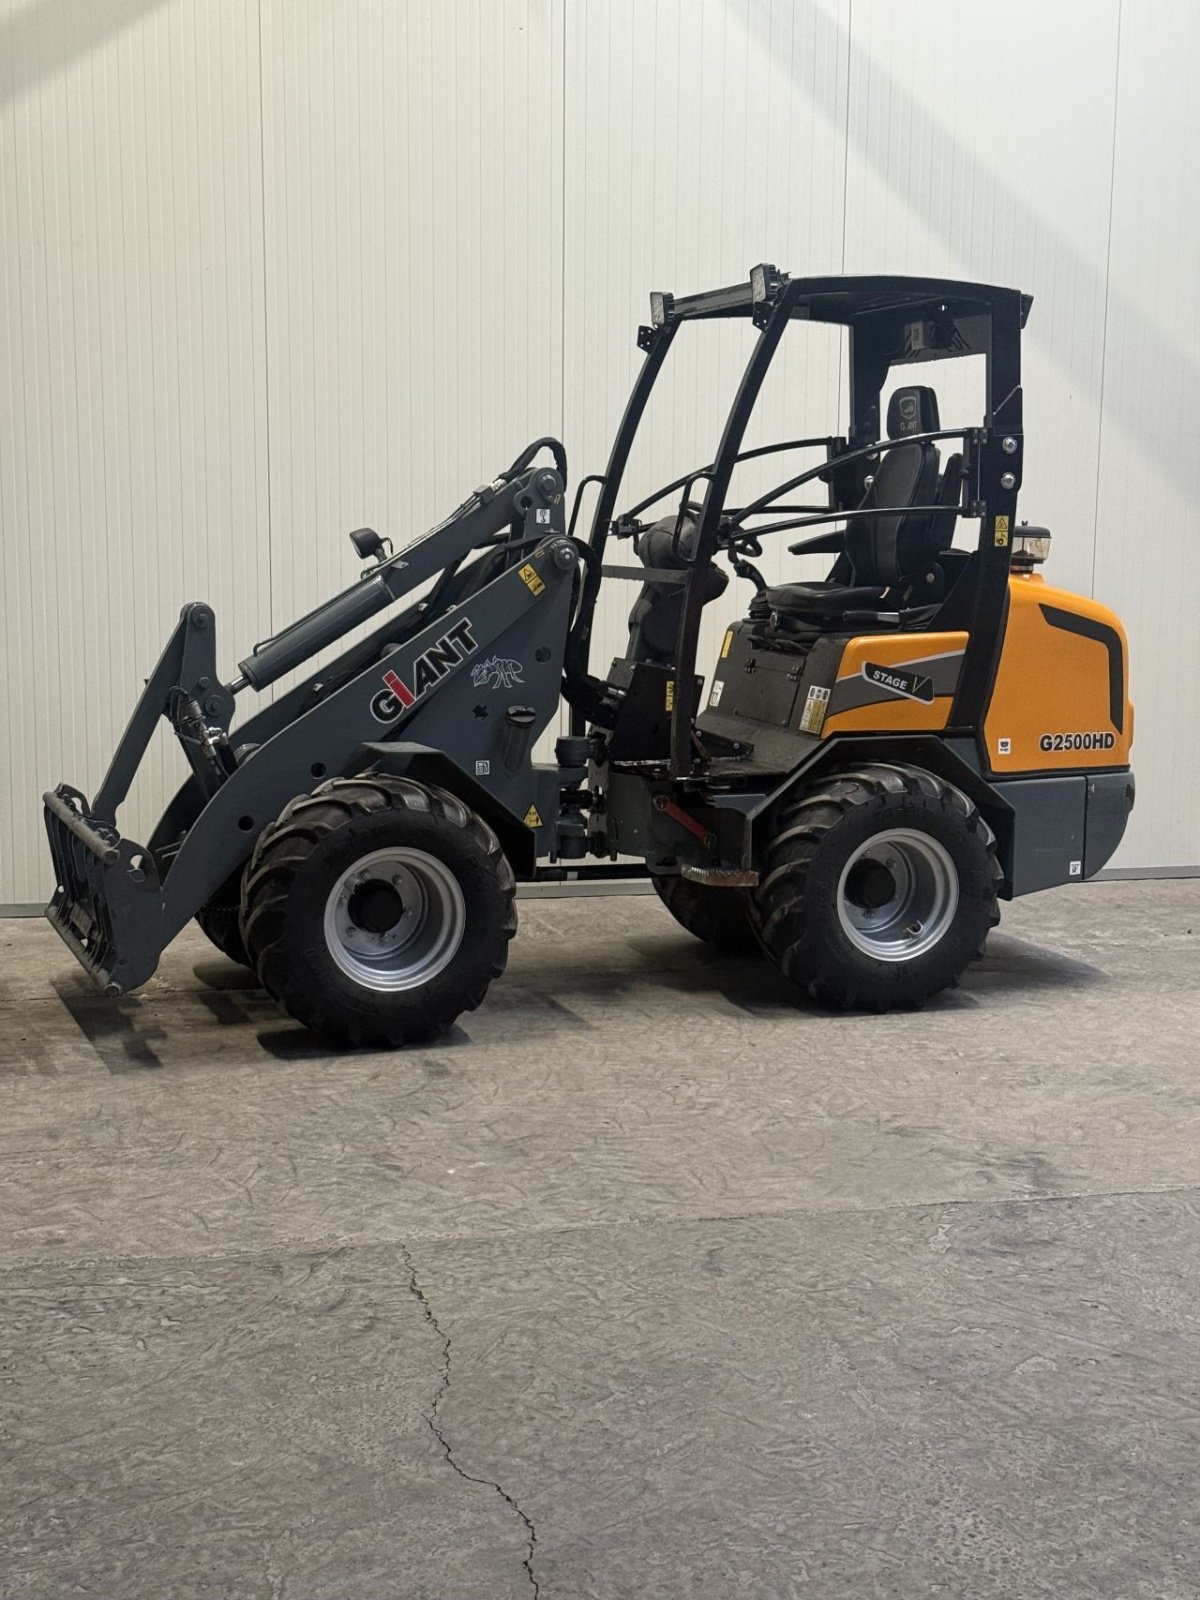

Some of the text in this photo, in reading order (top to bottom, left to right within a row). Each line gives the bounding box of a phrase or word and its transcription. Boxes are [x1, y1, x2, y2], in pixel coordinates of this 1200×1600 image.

[900, 421, 917, 431] GANT
[370, 617, 478, 723] GIANT
[872, 670, 930, 694] STAGE V
[1040, 732, 1116, 752] G2500HD
